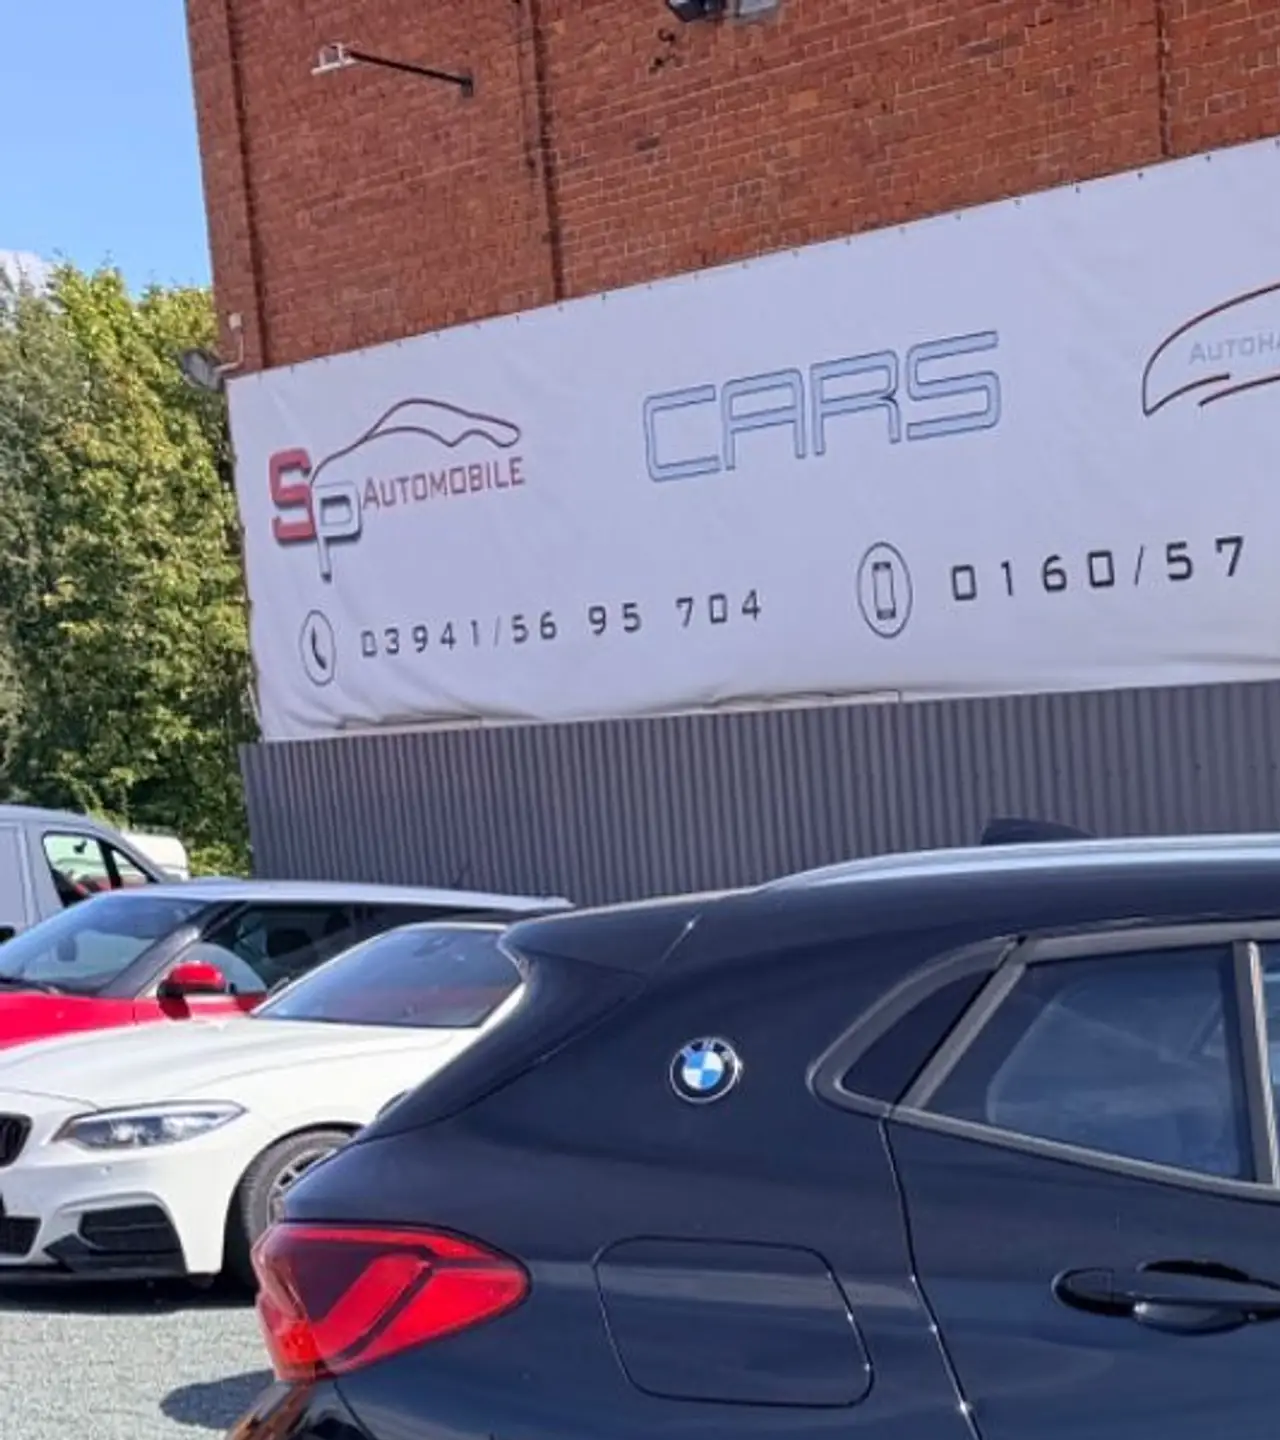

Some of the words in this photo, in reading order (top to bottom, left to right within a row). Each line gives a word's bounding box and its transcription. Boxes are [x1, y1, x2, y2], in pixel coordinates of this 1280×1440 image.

[642, 330, 1000, 482] CARS
[952, 536, 1246, 601] 0160/57
[361, 611, 558, 659] 03941/56
[588, 603, 642, 635] 95
[676, 590, 764, 628] 704
